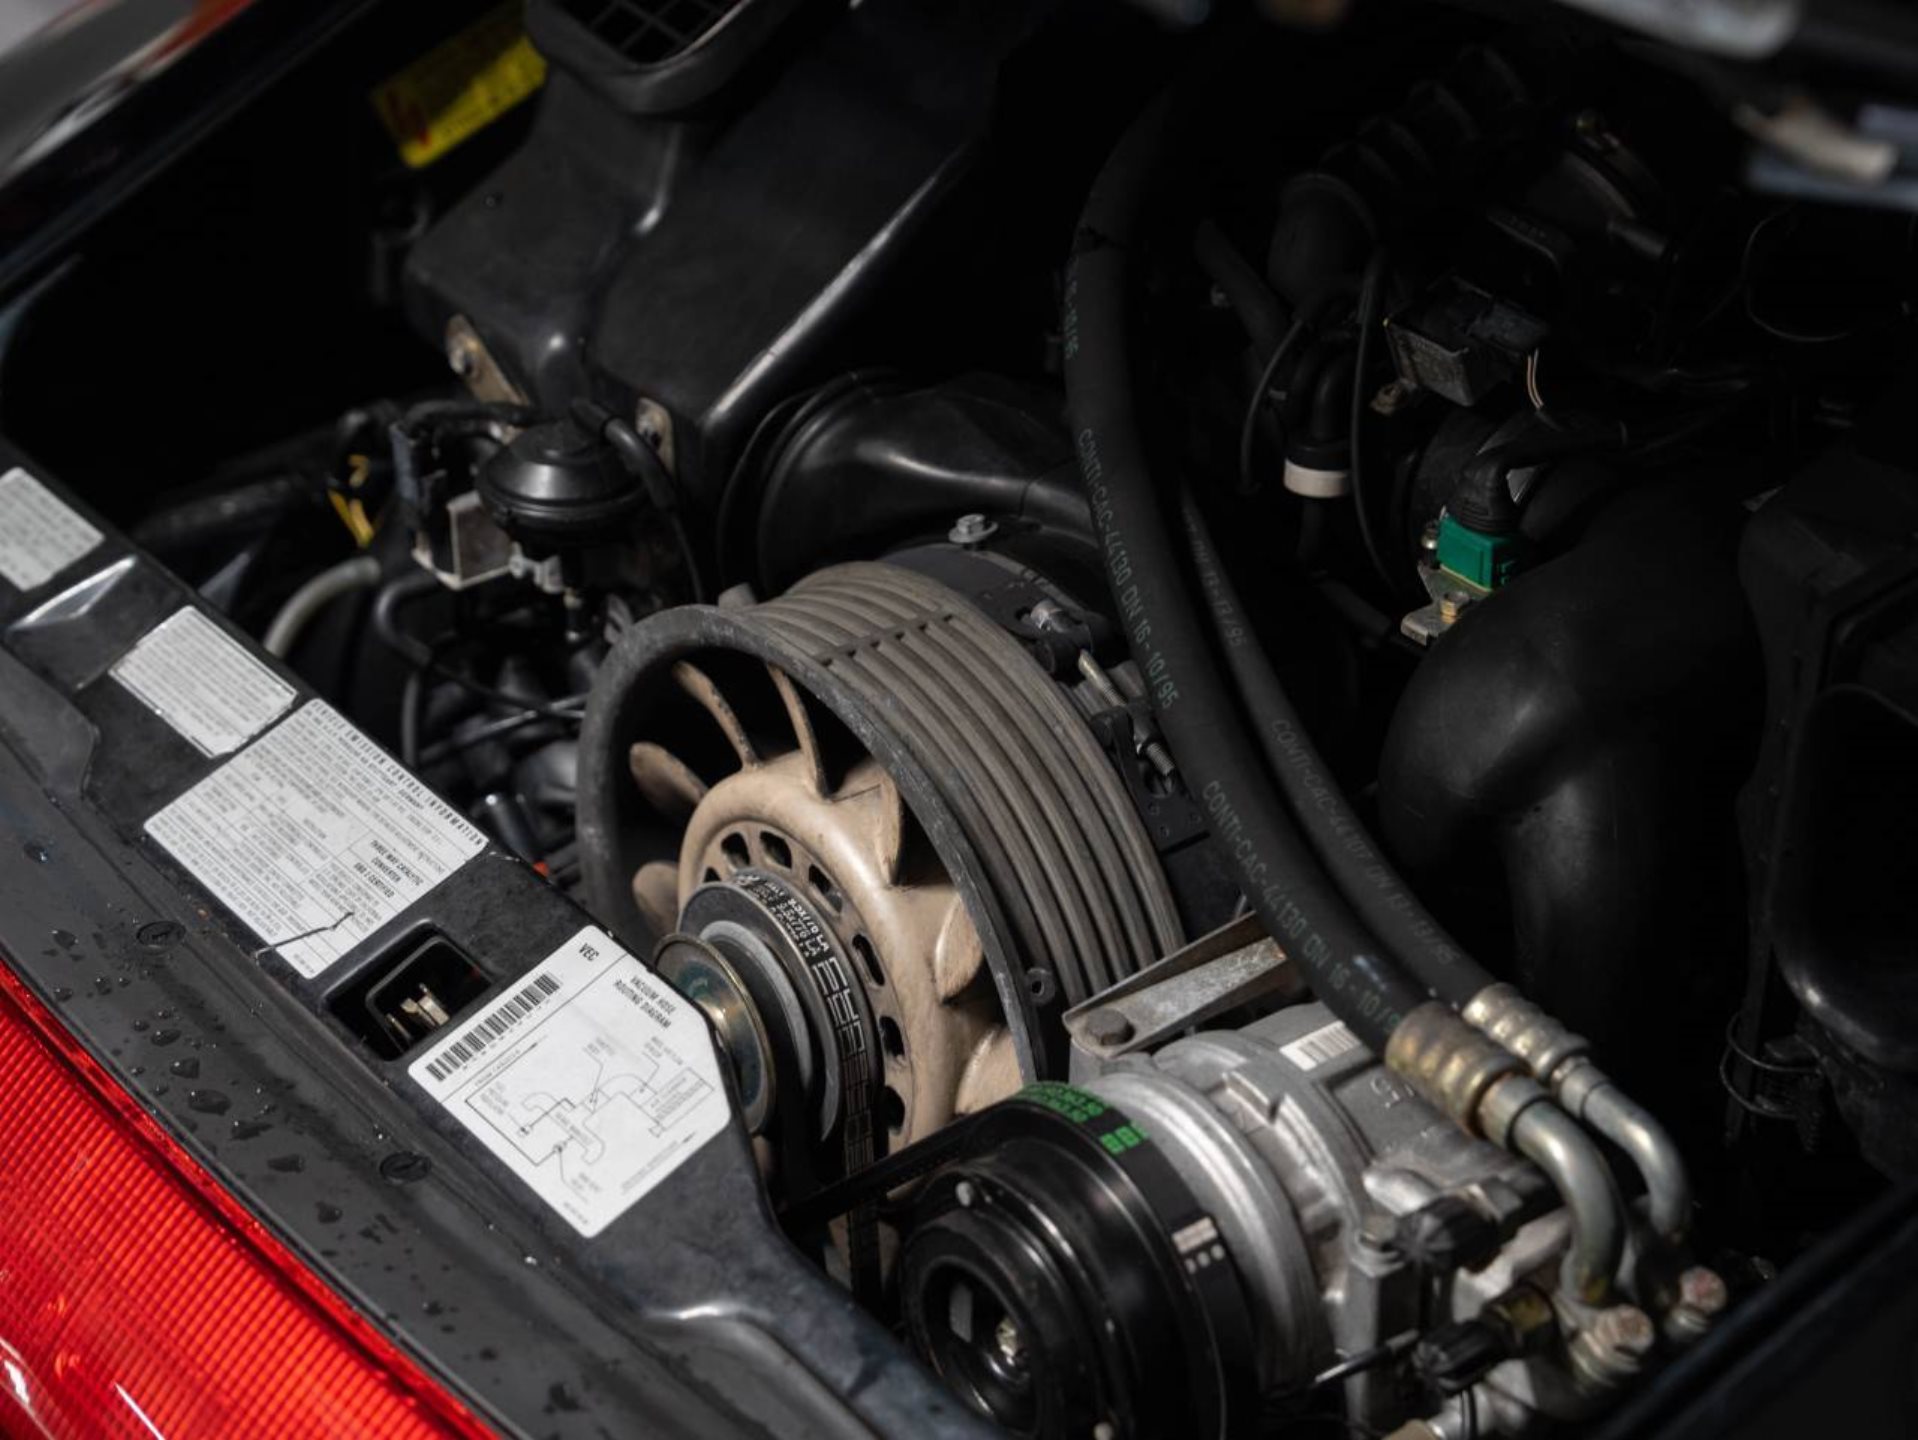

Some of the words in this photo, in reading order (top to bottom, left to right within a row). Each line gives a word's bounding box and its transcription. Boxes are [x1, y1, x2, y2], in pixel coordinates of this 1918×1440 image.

[1075, 426, 1133, 586] CONTI-CAC-44130
[1118, 585, 1145, 617] DN
[1133, 618, 1152, 644] 16
[1144, 650, 1180, 710] 10/95
[309, 700, 347, 732] VEHICLE
[343, 728, 391, 768] EMISSION
[385, 763, 426, 799] CONTROL
[422, 795, 484, 848] INFORMATION
[369, 838, 388, 856] THREE
[385, 851, 399, 865] WAY
[370, 856, 402, 884] CONVERTER
[1201, 778, 1309, 938] CONTI-CAC-44130
[1300, 933, 1333, 969] DN
[1325, 961, 1354, 991] 16
[577, 942, 600, 963] VEC
[612, 978, 643, 1005] ROUTING
[639, 1000, 672, 1029] DIAGRAM
[629, 974, 660, 1001] VACUUM
[654, 996, 677, 1015] HOSE
